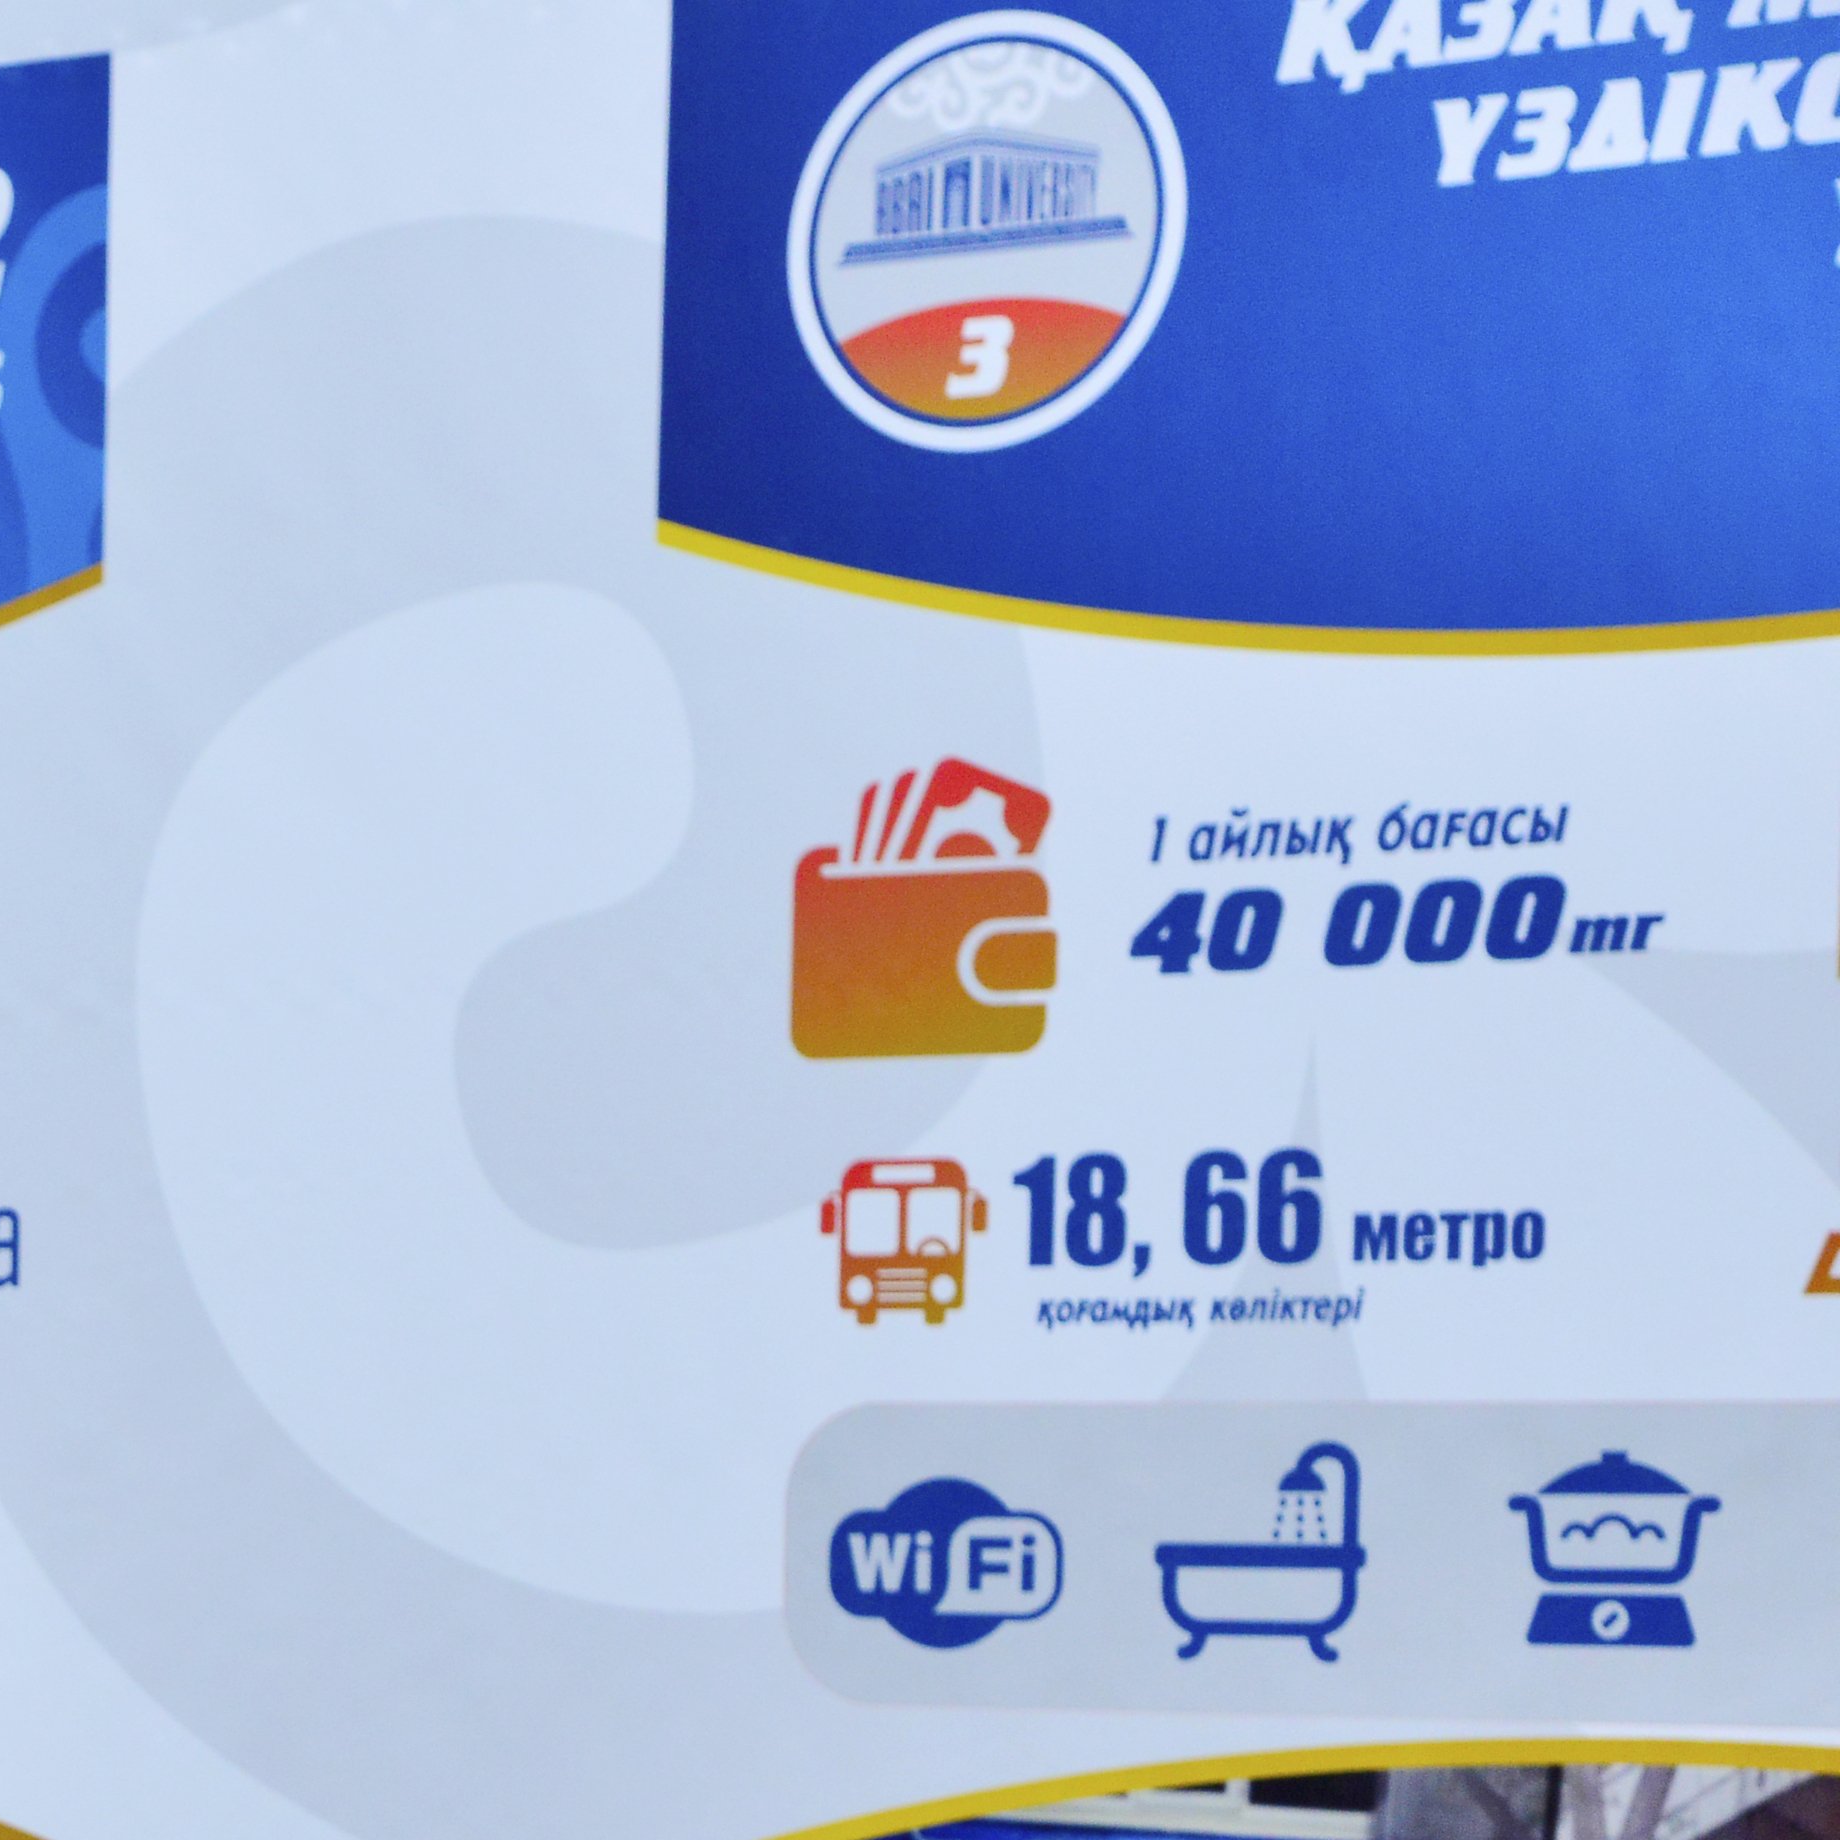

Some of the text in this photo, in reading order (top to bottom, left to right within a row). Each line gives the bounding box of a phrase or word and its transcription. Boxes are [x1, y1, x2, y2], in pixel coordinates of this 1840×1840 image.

[944, 315, 1015, 400] 3
[1187, 804, 1354, 864] айлық
[1377, 801, 1568, 857] бағасы
[1129, 888, 1284, 974] 40
[1012, 1147, 1545, 1277] 18, 66 метро
